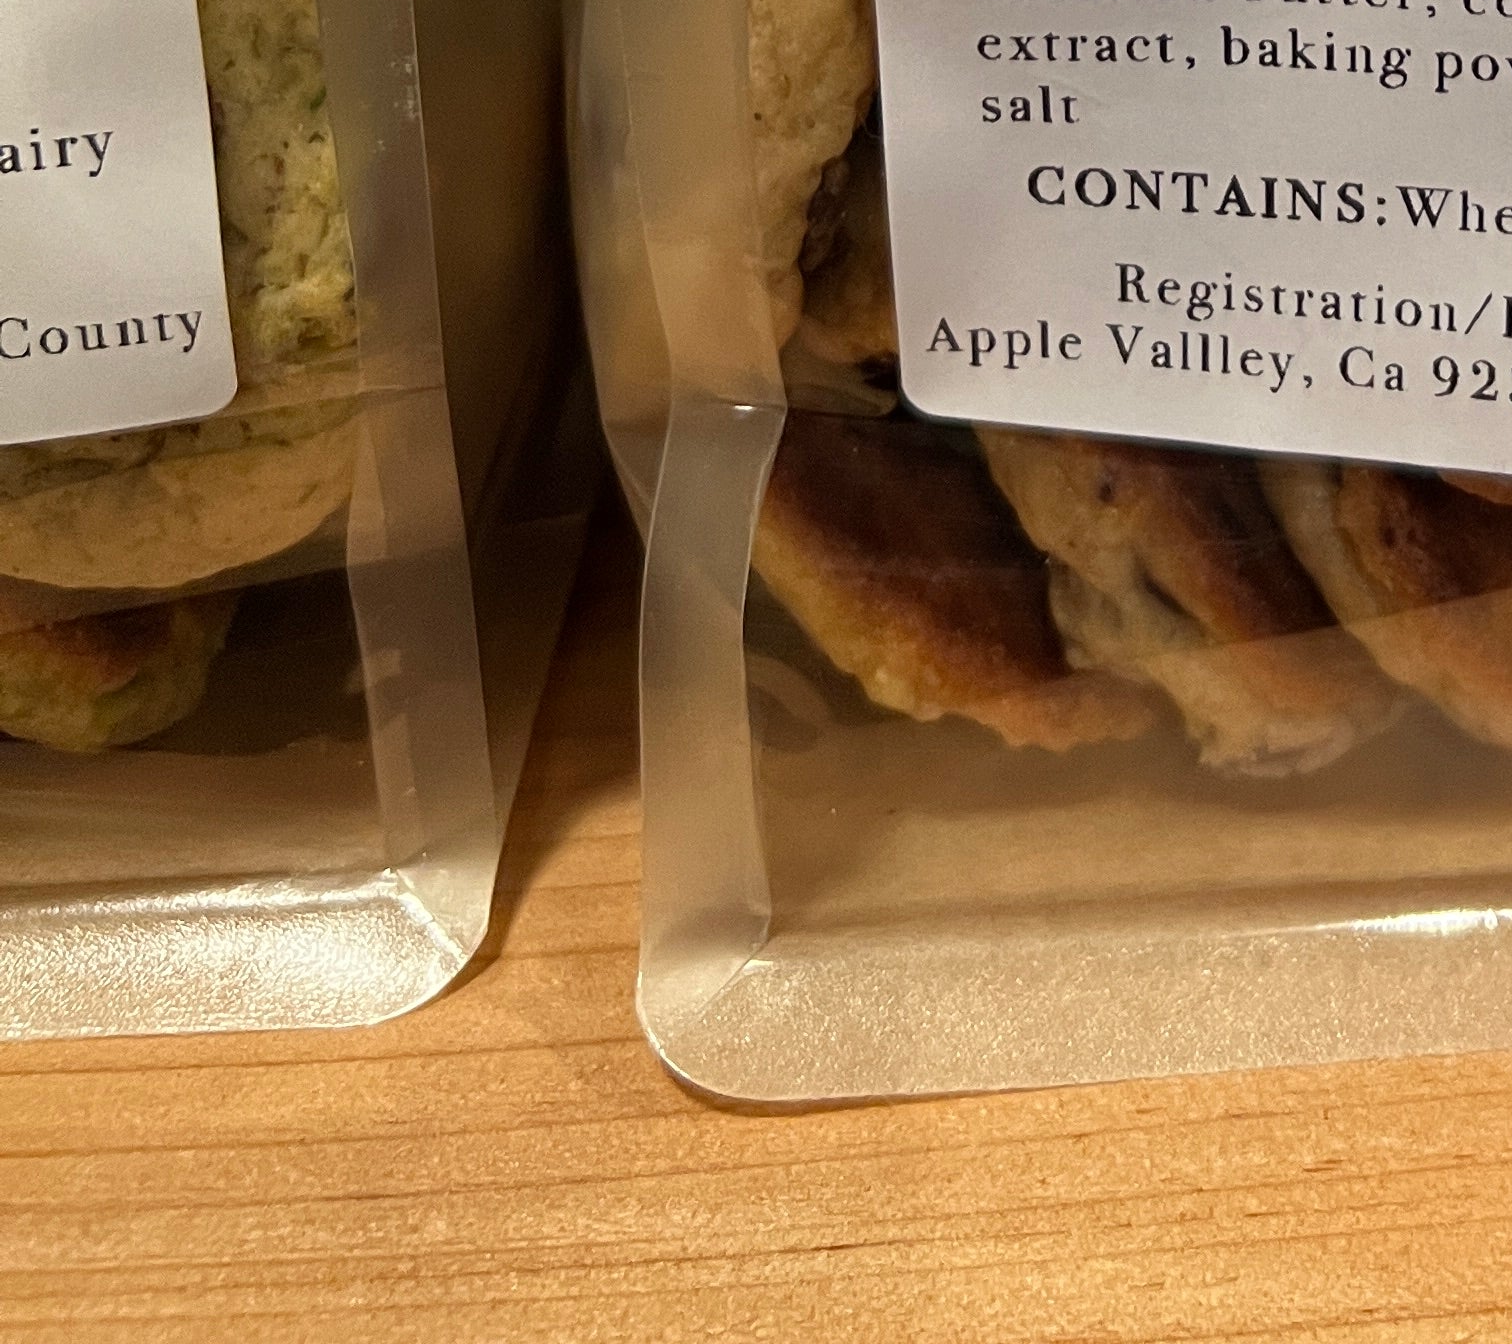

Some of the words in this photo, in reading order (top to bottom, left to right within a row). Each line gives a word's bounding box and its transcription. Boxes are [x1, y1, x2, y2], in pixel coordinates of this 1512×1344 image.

[976, 32, 1196, 71] extract,
[1220, 24, 1413, 91] baking
[981, 84, 1077, 125] salt
[0, 127, 113, 178] airy
[0, 311, 202, 360] County
[926, 317, 1082, 371] Apple
[1106, 323, 1313, 394] Vallley,
[1338, 345, 1405, 393] Ca
